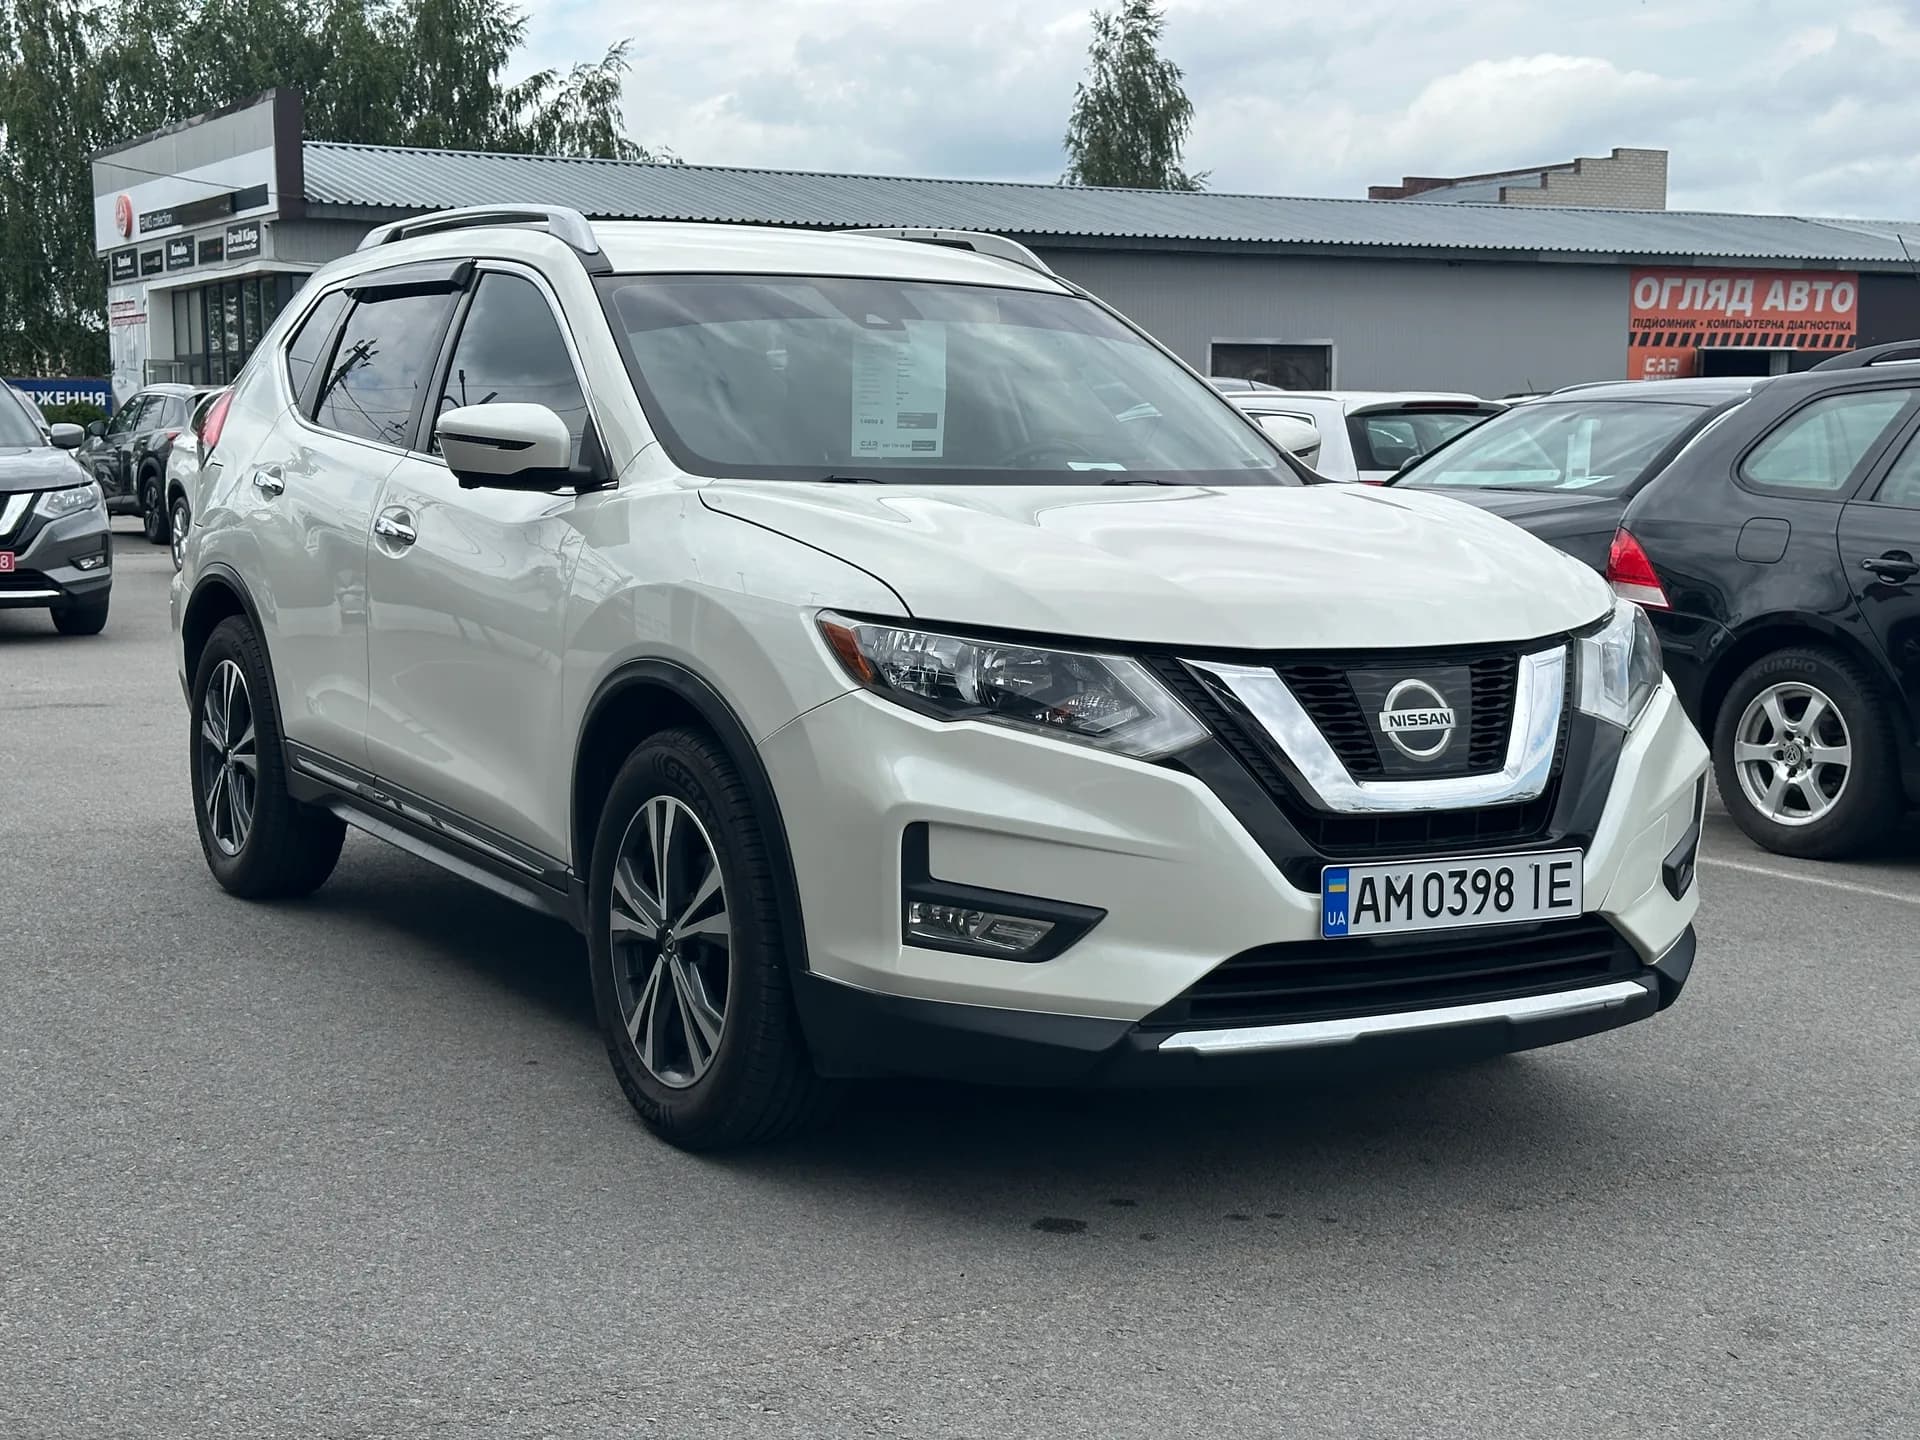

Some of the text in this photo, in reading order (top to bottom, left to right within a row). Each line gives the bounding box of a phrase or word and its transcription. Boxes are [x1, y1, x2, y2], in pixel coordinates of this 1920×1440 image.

[1633, 276, 1855, 317] ОГЛЯД АВТО
[1632, 317, 1697, 330] ПІДЙОМНИК
[1645, 357, 1679, 373] CAR
[1752, 658, 1817, 680] KUMHO
[1389, 711, 1451, 728] NISSAN
[1327, 911, 1346, 927] UA
